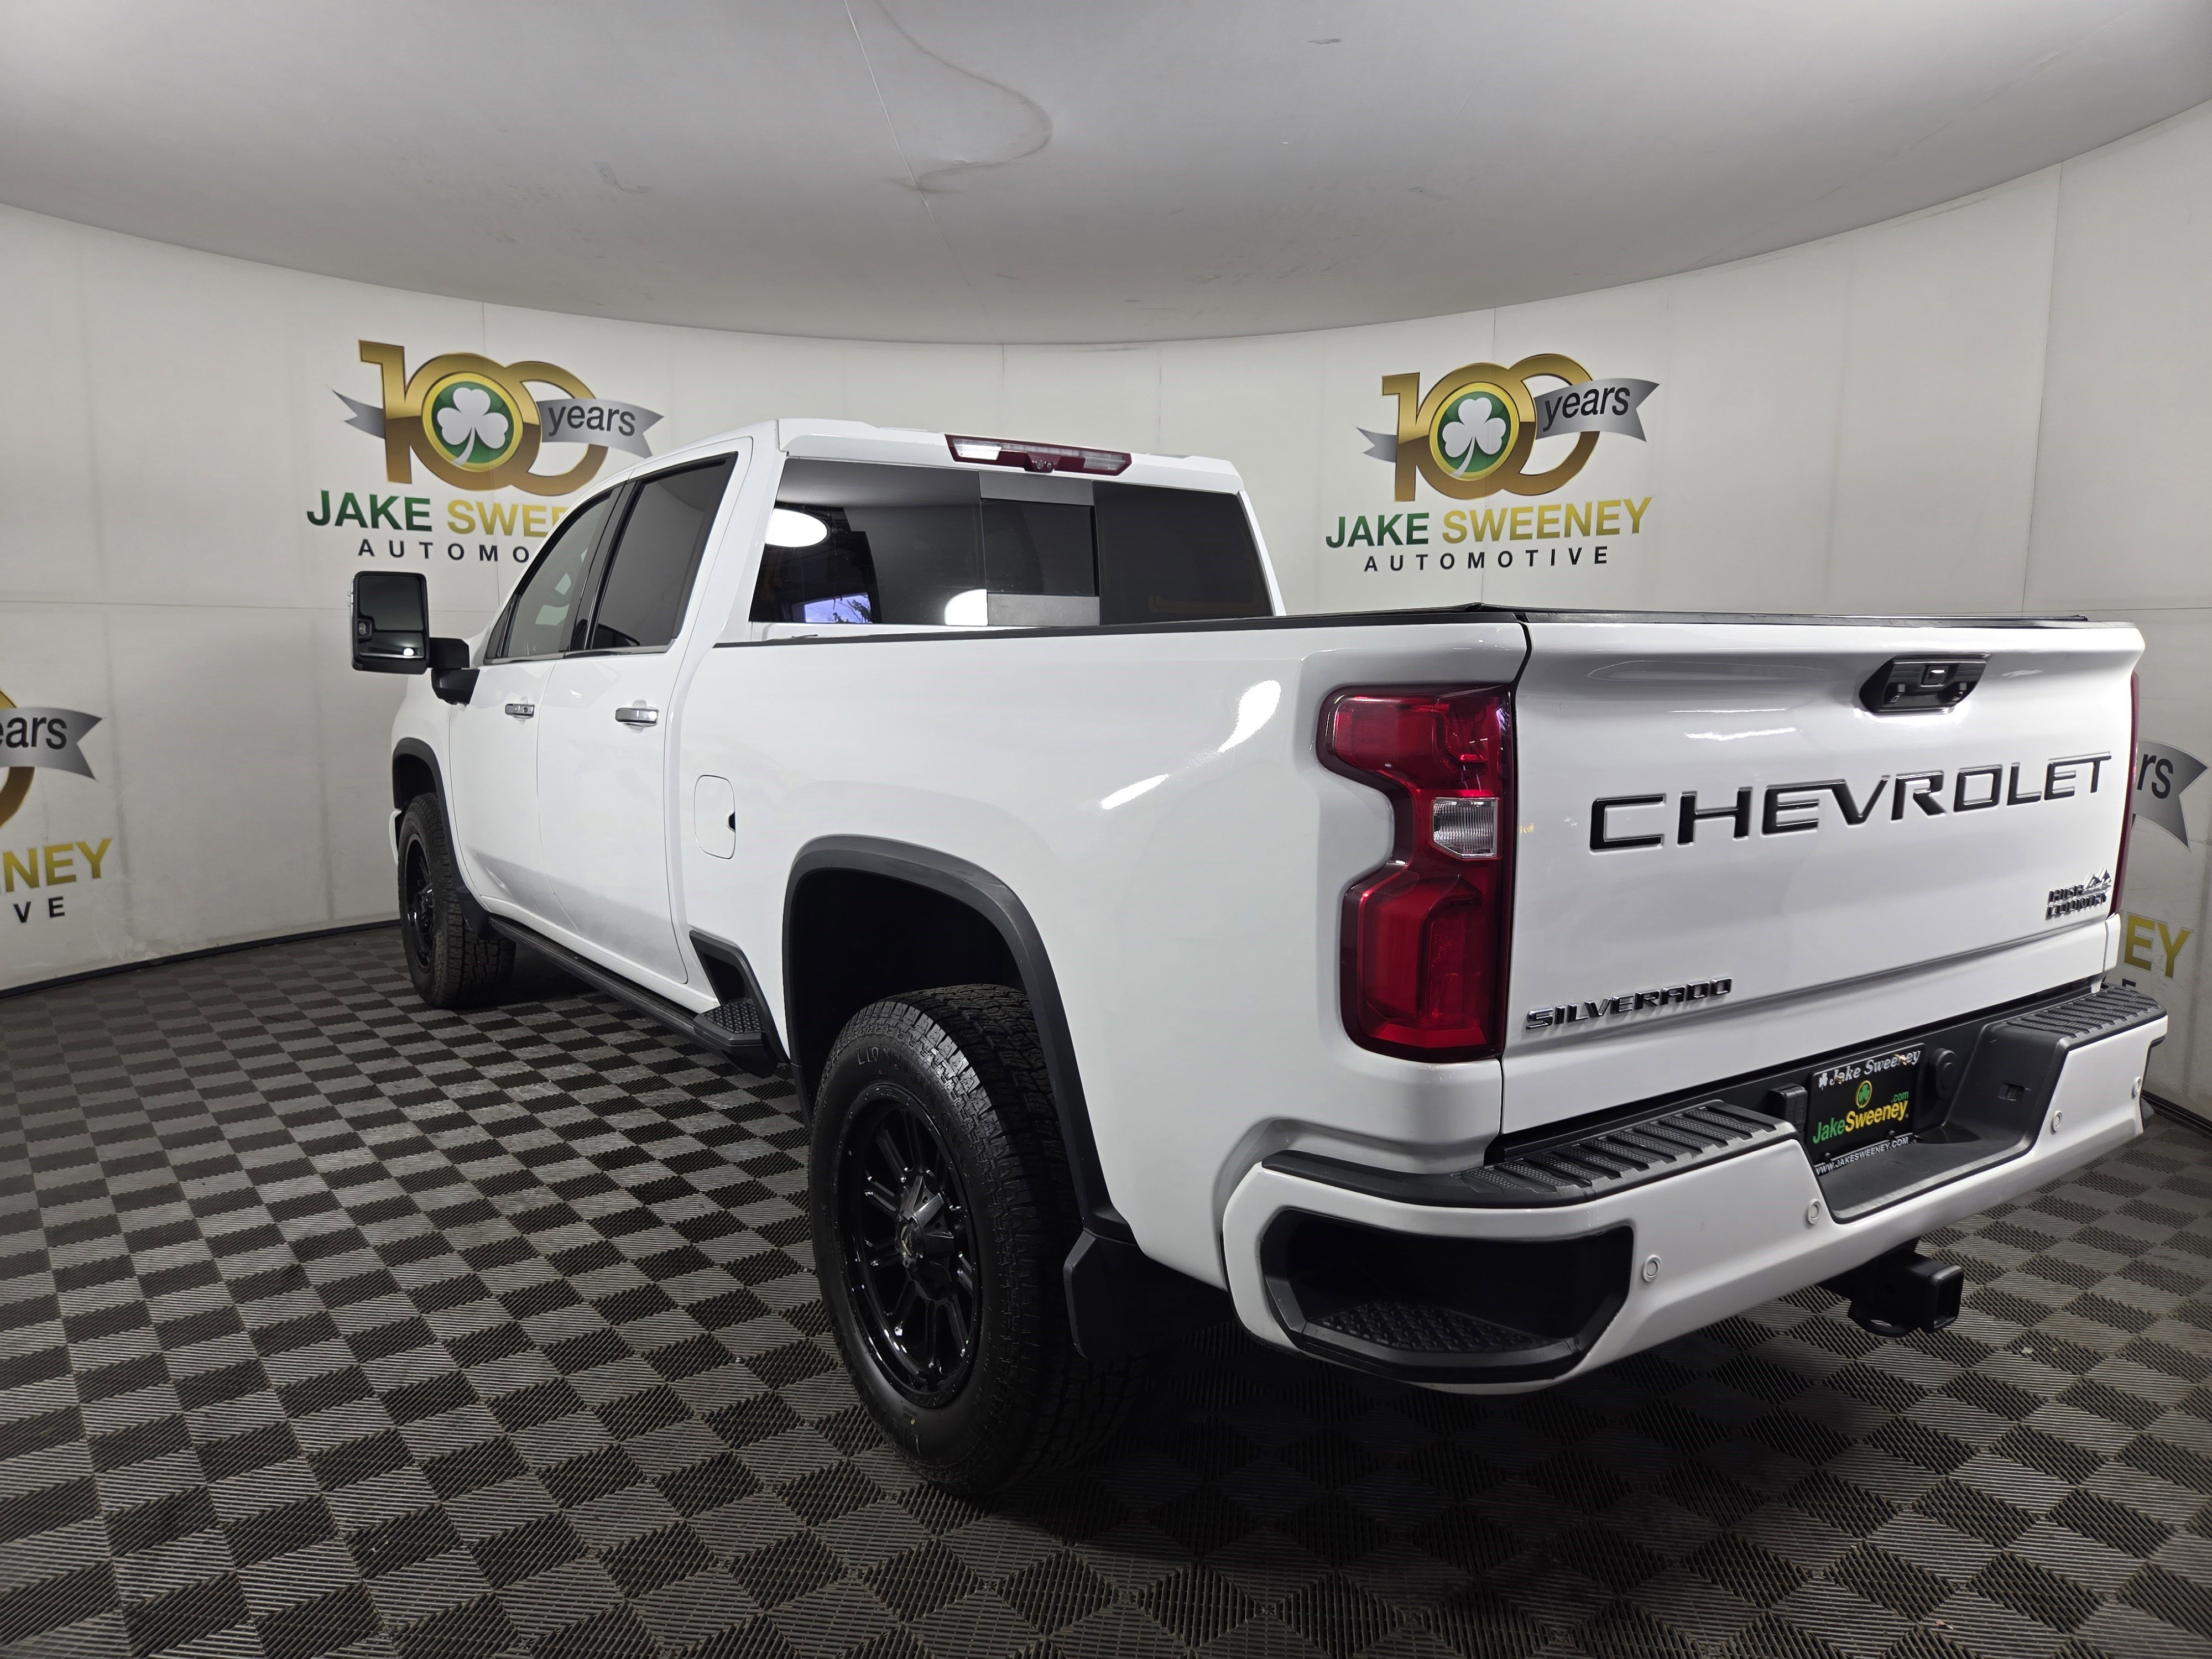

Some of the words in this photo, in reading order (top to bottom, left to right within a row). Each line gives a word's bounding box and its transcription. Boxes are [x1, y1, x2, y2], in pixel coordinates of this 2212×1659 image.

[358, 340, 609, 497] 100
[548, 404, 636, 437] years
[1382, 353, 1600, 502] 100
[1542, 385, 1630, 432] years
[306, 490, 432, 532] JAKE
[1325, 512, 1430, 549] JAKE
[1442, 497, 1653, 544] SWEENEY
[1364, 546, 1608, 572] AUTOMOTIVE
[1589, 752, 2112, 851] CHEVROLET
[1526, 977, 1733, 1030] SILVERADO
[1829, 1065, 1861, 1086] Jake
[1891, 1091, 1909, 1104] .com
[1813, 1100, 1908, 1144] JakeSweeney
